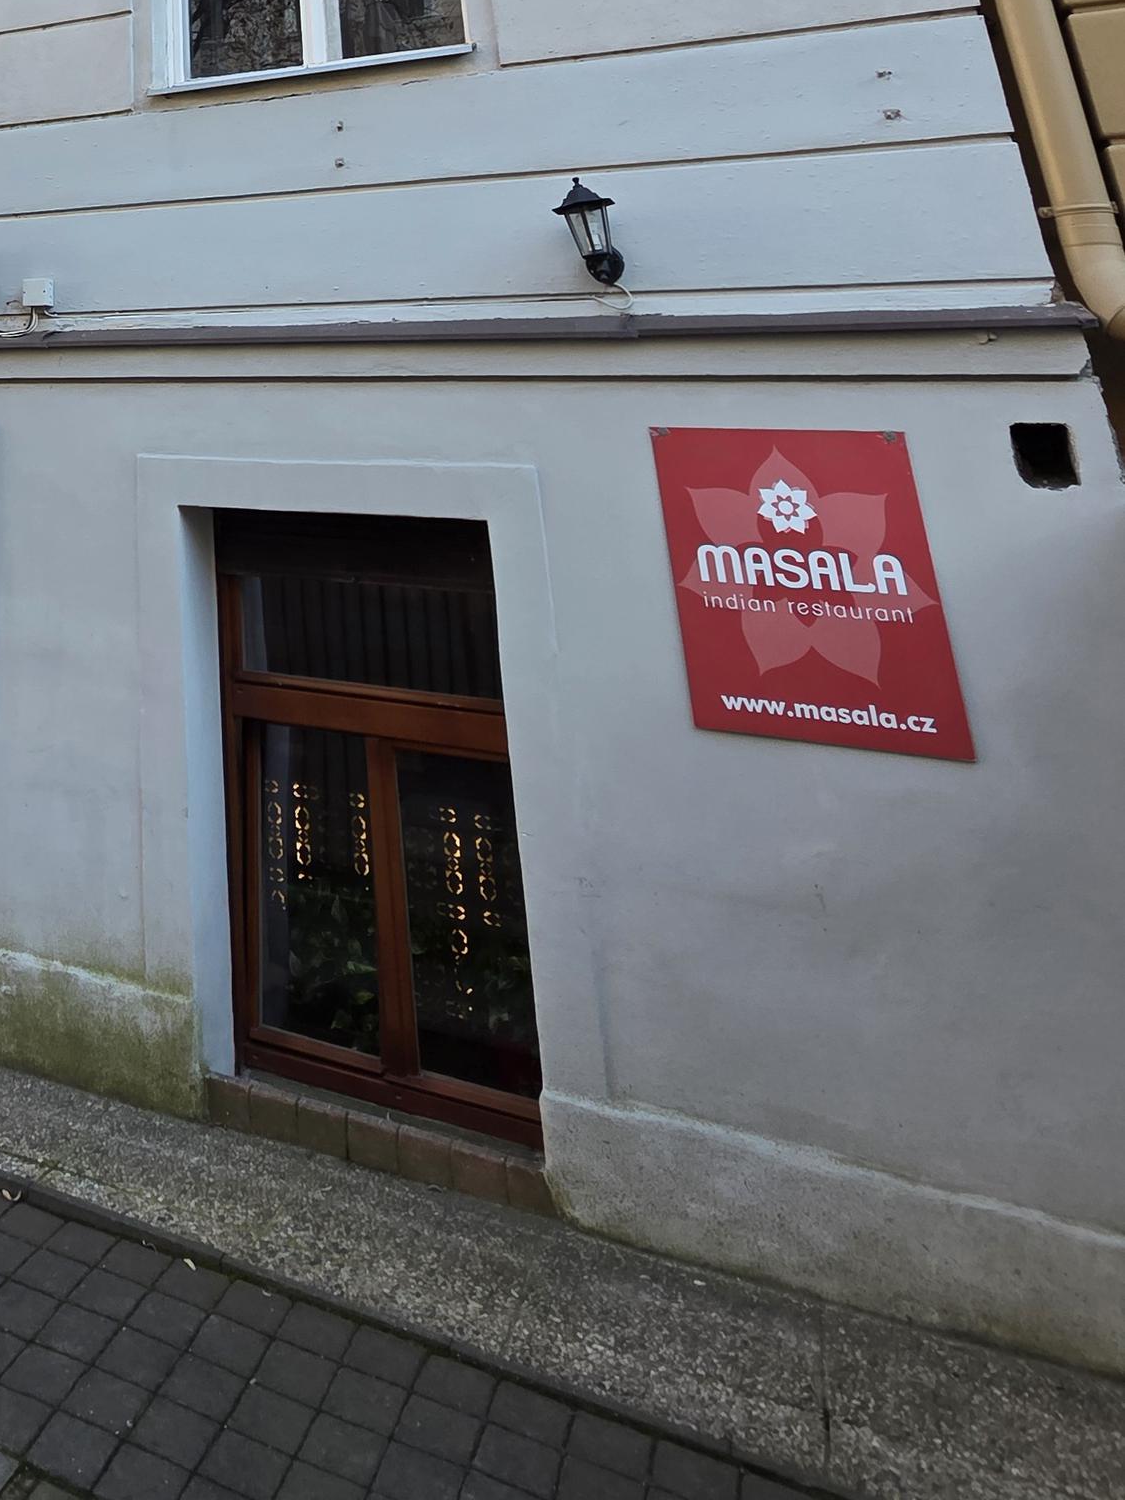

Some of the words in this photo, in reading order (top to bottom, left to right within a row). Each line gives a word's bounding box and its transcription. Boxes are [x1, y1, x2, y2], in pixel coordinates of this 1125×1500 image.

[697, 544, 909, 596] MASALA
[703, 590, 777, 614] indian
[787, 599, 915, 624] restaurant
[720, 693, 938, 735] www.masala.cz
